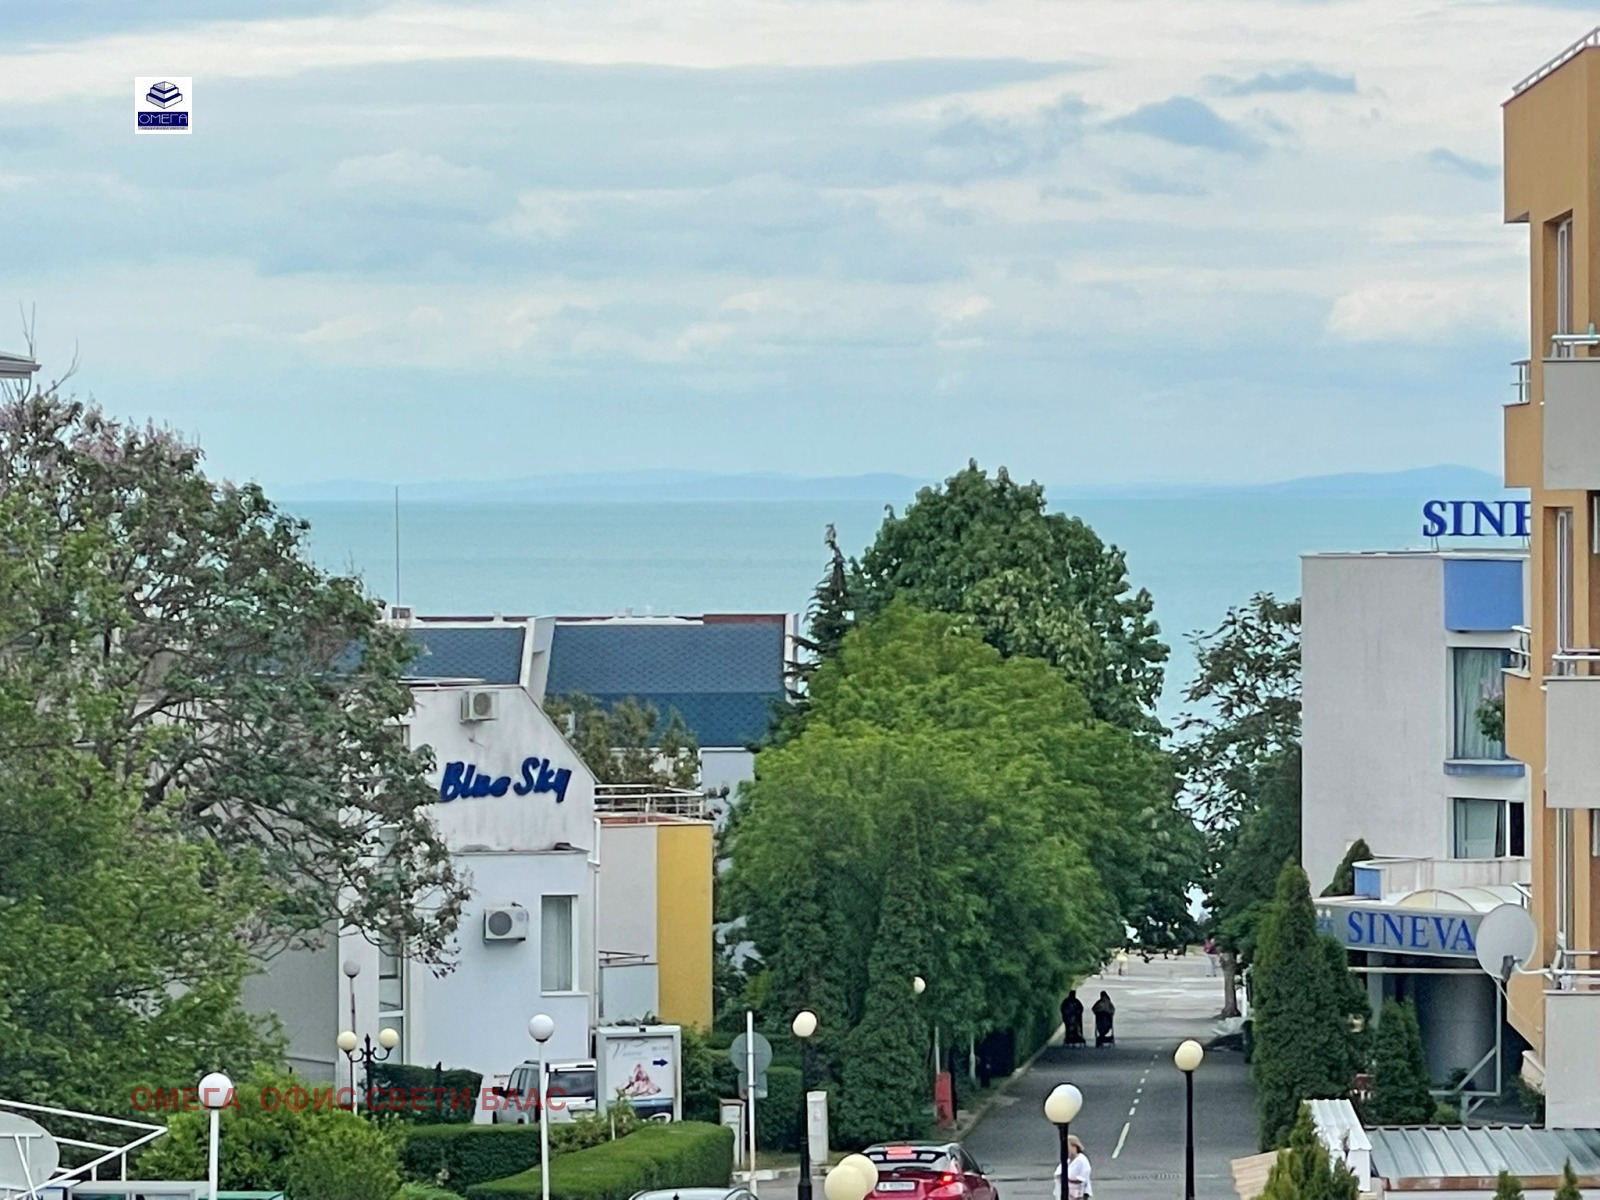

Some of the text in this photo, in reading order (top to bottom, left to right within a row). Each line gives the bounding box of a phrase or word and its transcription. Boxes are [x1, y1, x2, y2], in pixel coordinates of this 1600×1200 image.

[440, 756, 572, 803] Blue Sky
[1348, 910, 1477, 951] SINEVA
